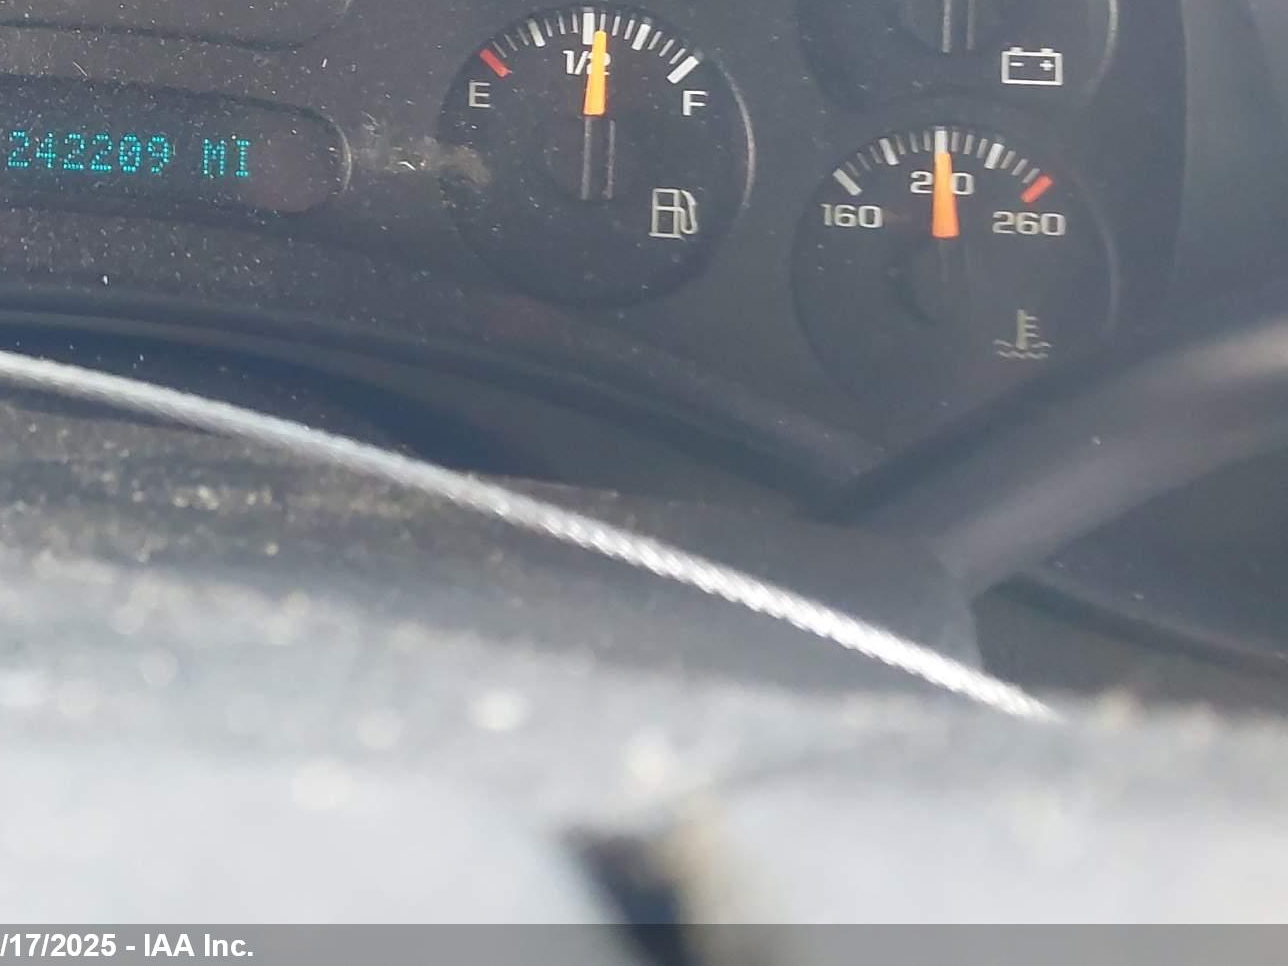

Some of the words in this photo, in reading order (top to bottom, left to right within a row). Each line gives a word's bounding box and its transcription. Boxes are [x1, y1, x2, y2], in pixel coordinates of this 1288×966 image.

[468, 80, 491, 108] E
[682, 90, 708, 116] F
[7, 130, 171, 174] 242209
[202, 137, 251, 178] MI
[910, 170, 975, 196] 20
[821, 203, 883, 229] 160
[992, 210, 1066, 236] 260
